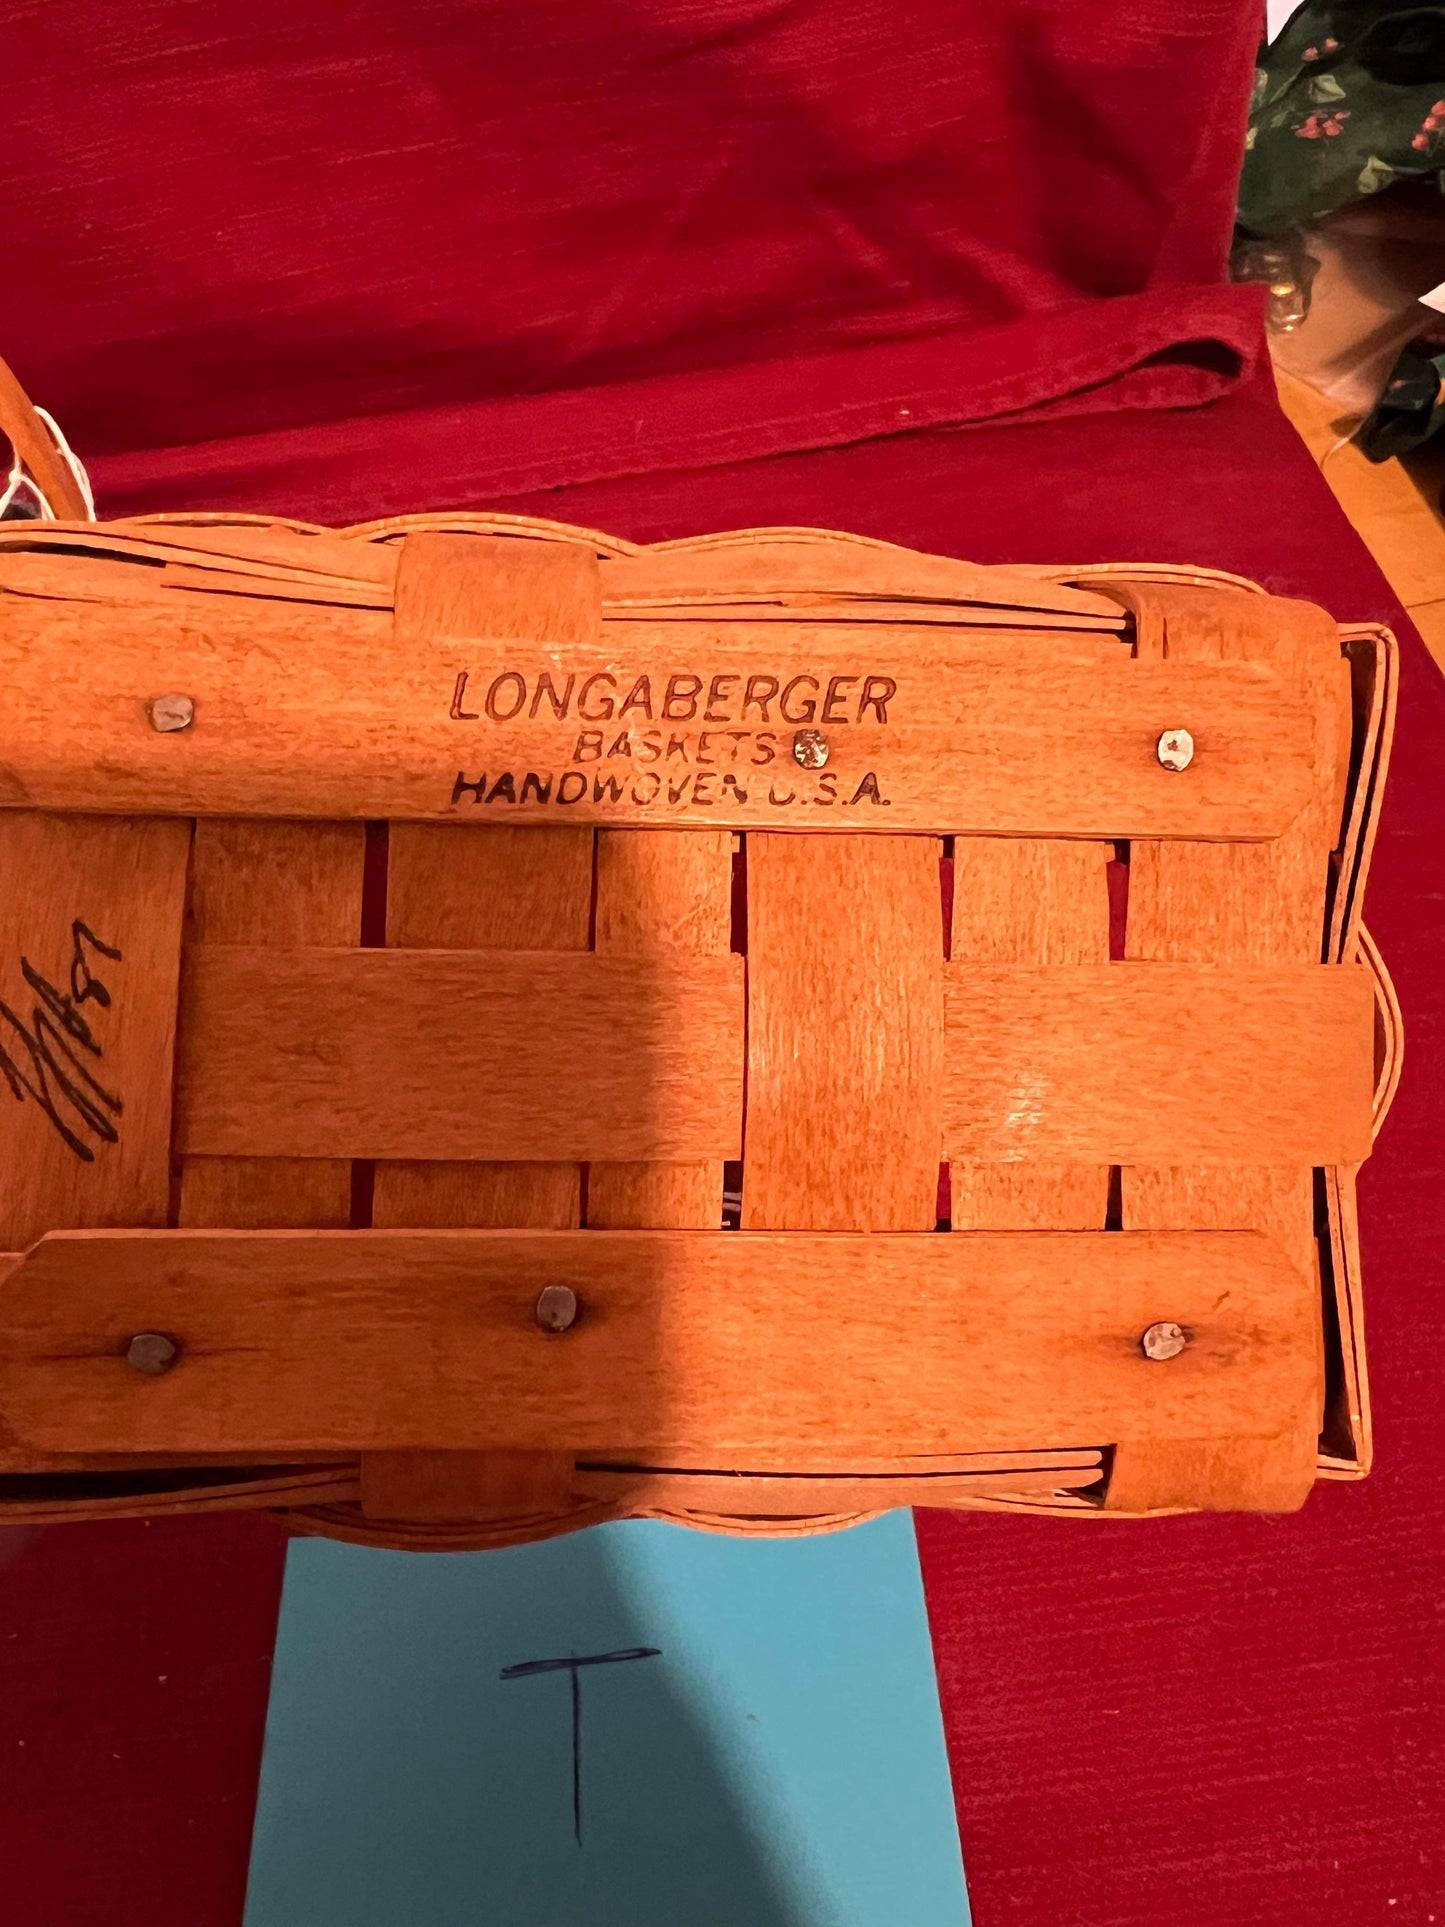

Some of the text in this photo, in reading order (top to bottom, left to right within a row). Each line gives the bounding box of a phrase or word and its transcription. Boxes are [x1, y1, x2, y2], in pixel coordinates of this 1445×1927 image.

[450, 671, 897, 724] LONGABERGER
[572, 730, 777, 766] BASKETS
[451, 771, 749, 806] HANDWOVEN
[500, 1647, 662, 1848] T
